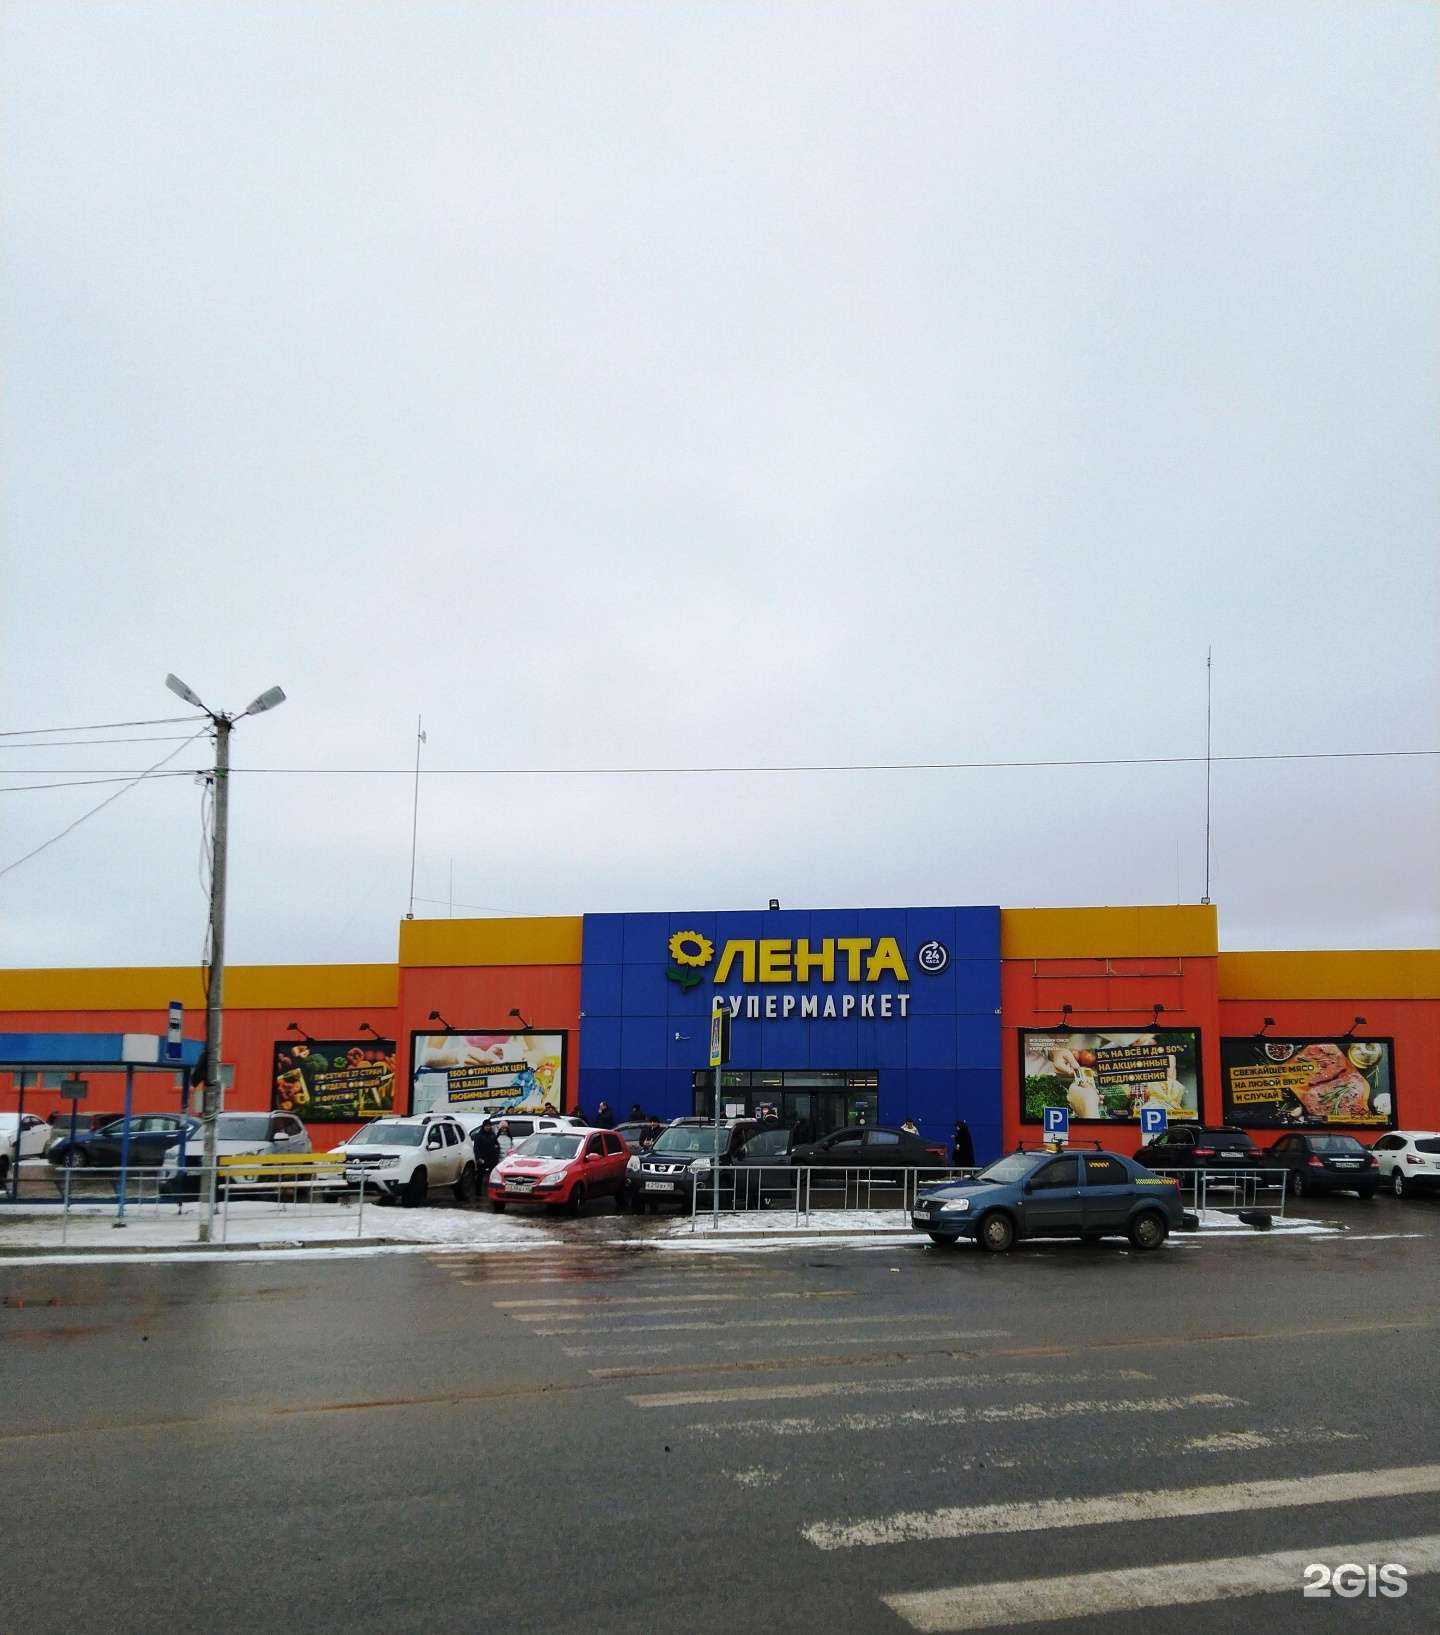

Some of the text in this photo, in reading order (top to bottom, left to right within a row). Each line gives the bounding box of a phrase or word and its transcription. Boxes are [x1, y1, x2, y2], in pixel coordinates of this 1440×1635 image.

[713, 937, 909, 983] ЛЕНТА
[925, 950, 940, 960] 24
[712, 993, 910, 1018] СУПЕРМАРКЕТ
[1097, 1051, 1110, 1059] 5%
[1111, 1050, 1124, 1058] НА
[1125, 1047, 1142, 1058] ВСЁ
[1143, 1048, 1150, 1056] И
[1151, 1047, 1165, 1056] ДО
[449, 1063, 526, 1078] 1500 ОТЛИЧНЫХ ЦЕН
[1099, 1059, 1167, 1072] НА АКЦИОННЫЕ
[1233, 1064, 1315, 1077] СВЕЖАЙШЕЕ МЯСО
[462, 1080, 485, 1088] ВАШИ
[1100, 1072, 1166, 1084] ПРЕДЛОЖЕНИЯ
[1235, 1077, 1305, 1088] НА ЛЮБОЙ ВКУС
[450, 1088, 522, 1101] ЛЮБИМЫЕ БРЕНДЫ
[1236, 1090, 1279, 1101] И СЛУЧАЙ
[1049, 1111, 1063, 1130] P
[1147, 1111, 1161, 1131] P
